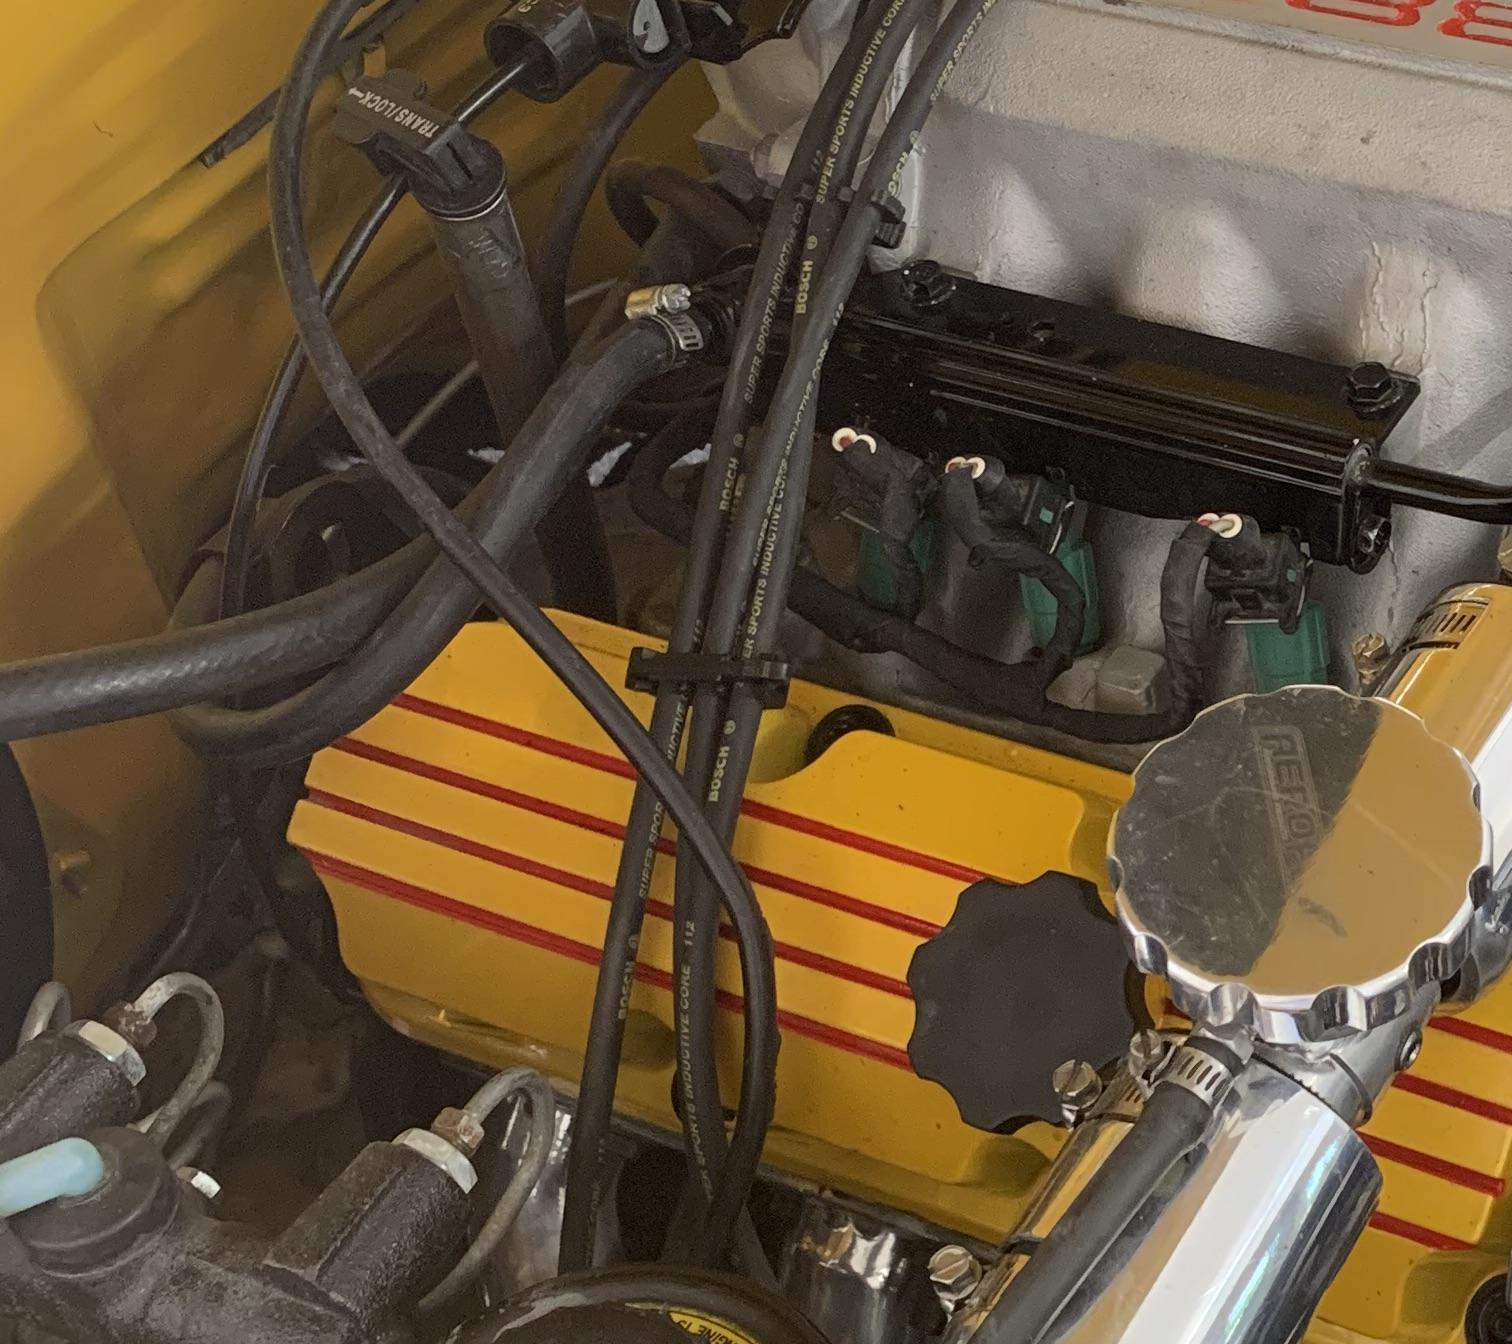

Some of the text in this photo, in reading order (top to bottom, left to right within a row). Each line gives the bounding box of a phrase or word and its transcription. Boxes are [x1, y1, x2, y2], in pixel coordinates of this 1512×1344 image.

[929, 59, 954, 102] SUPER
[952, 9, 983, 62] SPORTS
[358, 91, 440, 138] TRANS/LOCK
[816, 157, 836, 204] SUPER
[830, 97, 855, 155] SPORTS
[849, 29, 887, 103] INDUCTIVE
[795, 260, 814, 315] BOSCH
[744, 355, 763, 405] SUPER
[756, 296, 778, 355] SPORTS
[719, 457, 740, 511] BOSCH
[747, 579, 767, 635] SPORTS
[760, 503, 782, 576] INDUCTIVE
[708, 745, 730, 802] BOSCH
[639, 848, 654, 901] SUPER
[649, 802, 662, 841] SPOR
[684, 921, 697, 946] 112
[618, 960, 636, 1020] BOSCH
[678, 963, 693, 1011] CORE
[678, 1013, 694, 1099] INDUCTIVE
